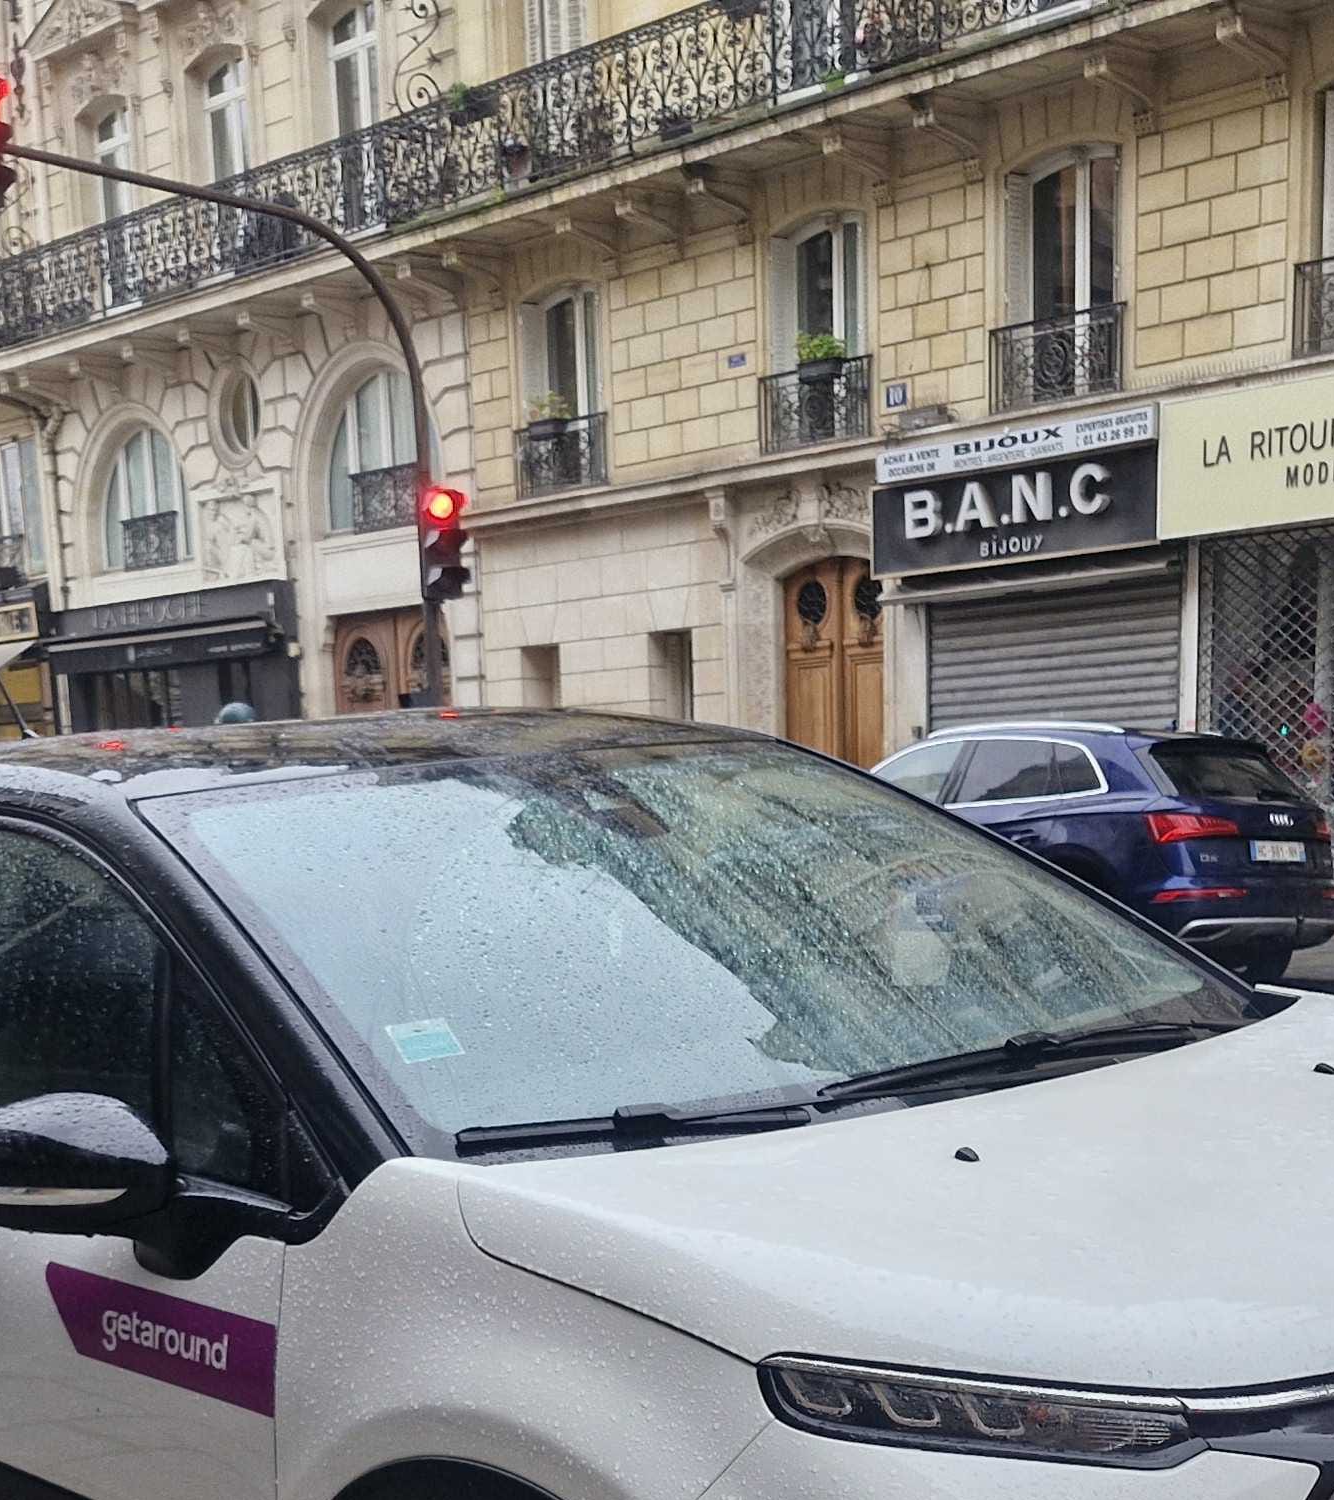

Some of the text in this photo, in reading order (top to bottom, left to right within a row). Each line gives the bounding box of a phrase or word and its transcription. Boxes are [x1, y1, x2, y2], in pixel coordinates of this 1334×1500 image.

[889, 386, 904, 406] 10
[953, 427, 1062, 456] BIJOUX
[1203, 435, 1231, 468] LA
[102, 1310, 228, 1371] getaround
